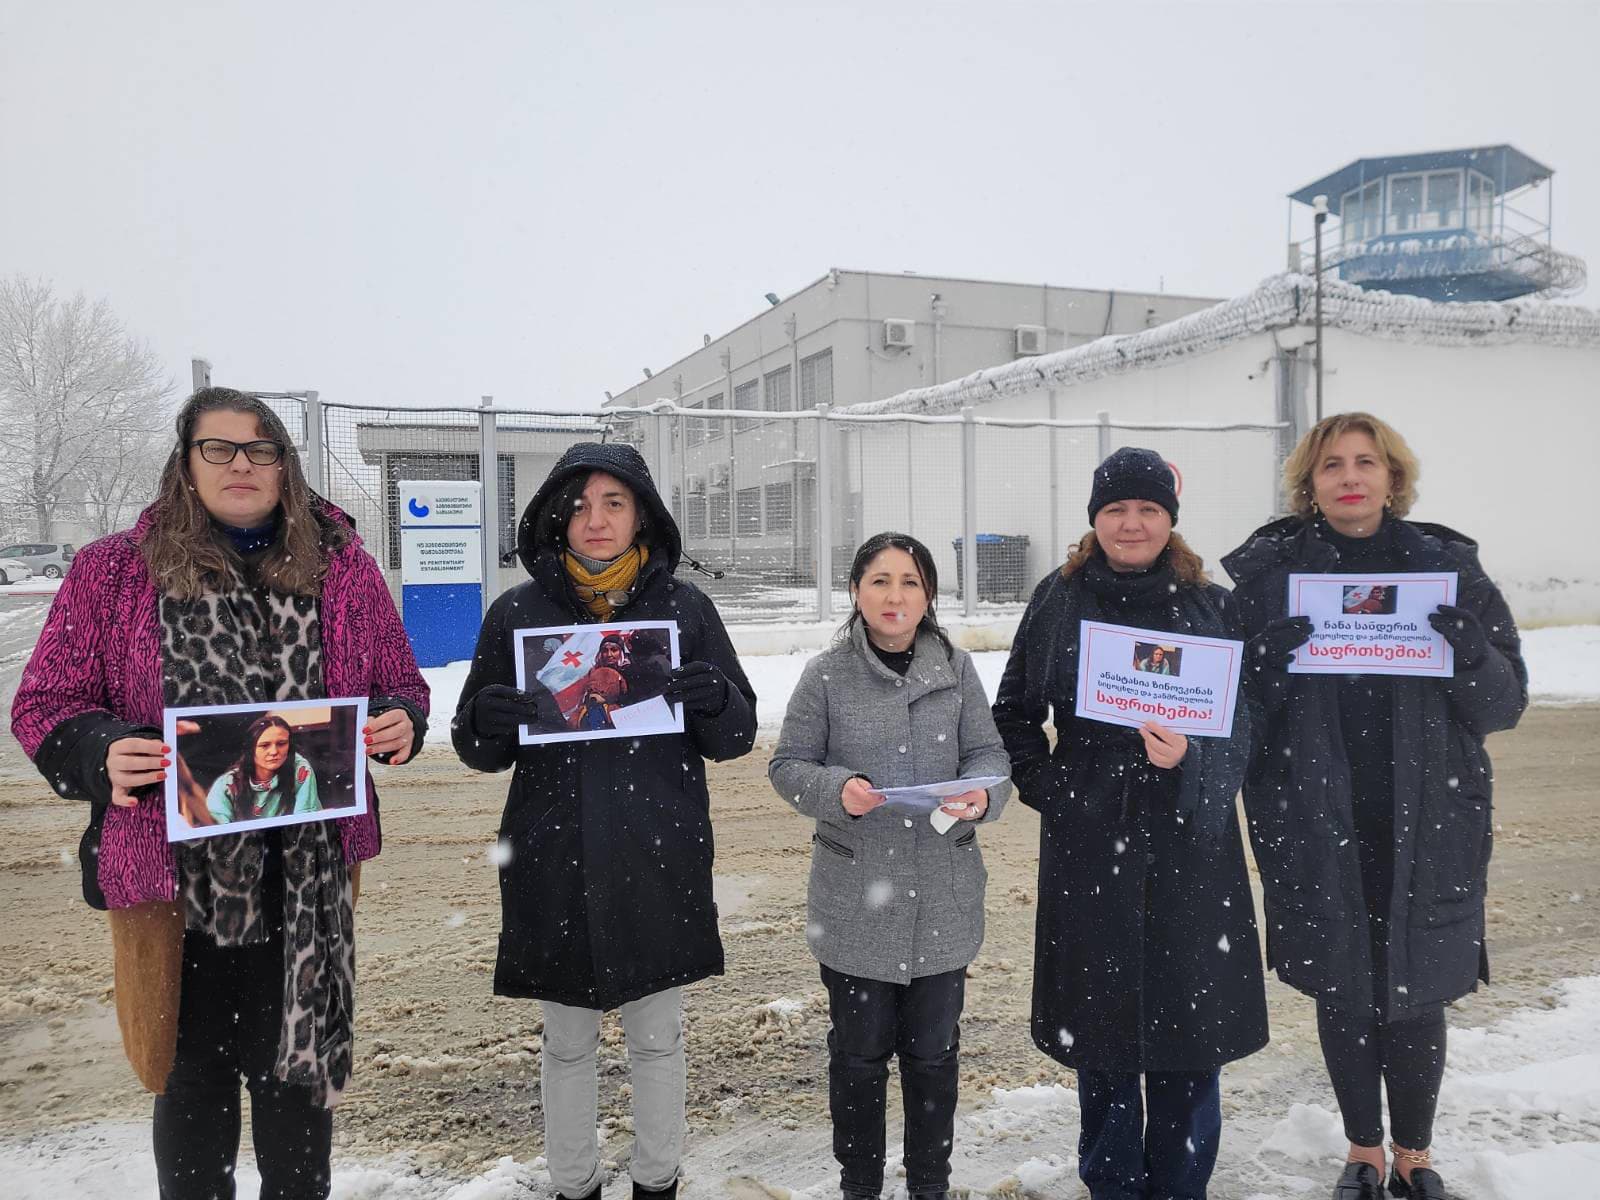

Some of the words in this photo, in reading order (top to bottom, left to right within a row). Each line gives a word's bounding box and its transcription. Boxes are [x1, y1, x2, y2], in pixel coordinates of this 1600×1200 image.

[1324, 620, 1351, 630] ნანა
[1369, 633, 1432, 642] ჯანმრთელობა
[1309, 643, 1432, 661] საფრთხეშია!
[1100, 671, 1150, 687] ანასტასია
[1152, 680, 1213, 696] ზინოვკინას
[1096, 689, 1213, 721] საფრთხეშია!
[1140, 689, 1152, 697] და
[1152, 691, 1214, 705] ჯანმრთელობა
